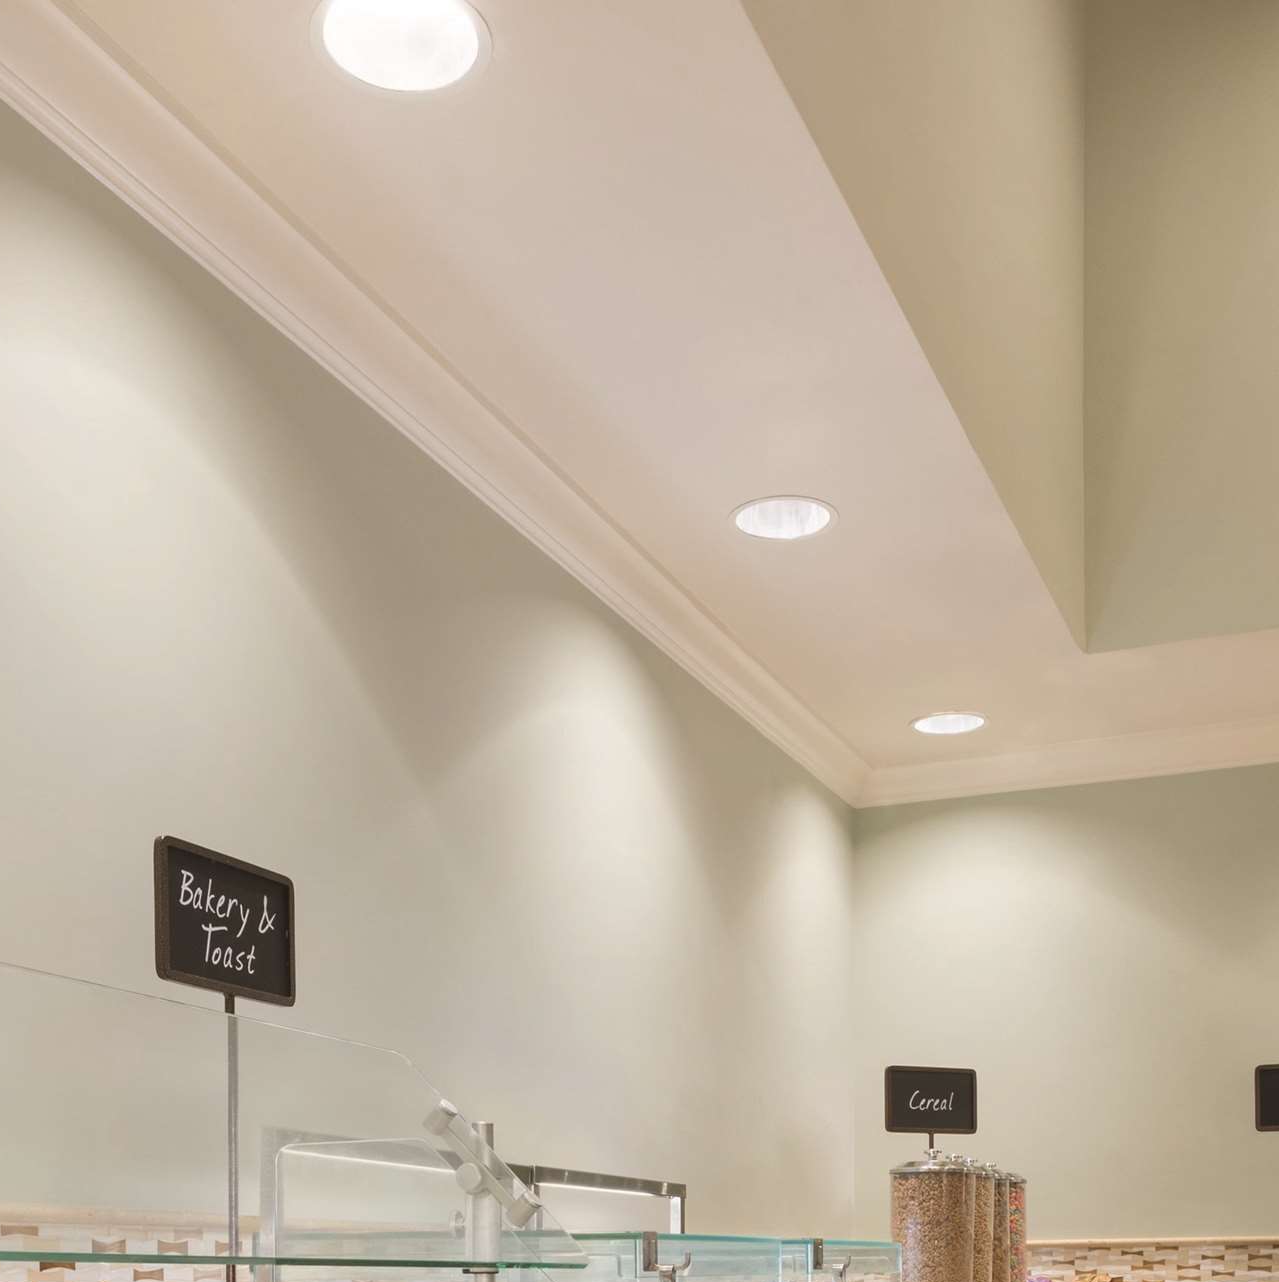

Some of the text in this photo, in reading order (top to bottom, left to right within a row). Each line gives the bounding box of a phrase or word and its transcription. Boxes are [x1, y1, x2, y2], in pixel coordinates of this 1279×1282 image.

[179, 869, 278, 938] Bakery &
[201, 923, 257, 975] Toast
[909, 1090, 954, 1111] Cereal
